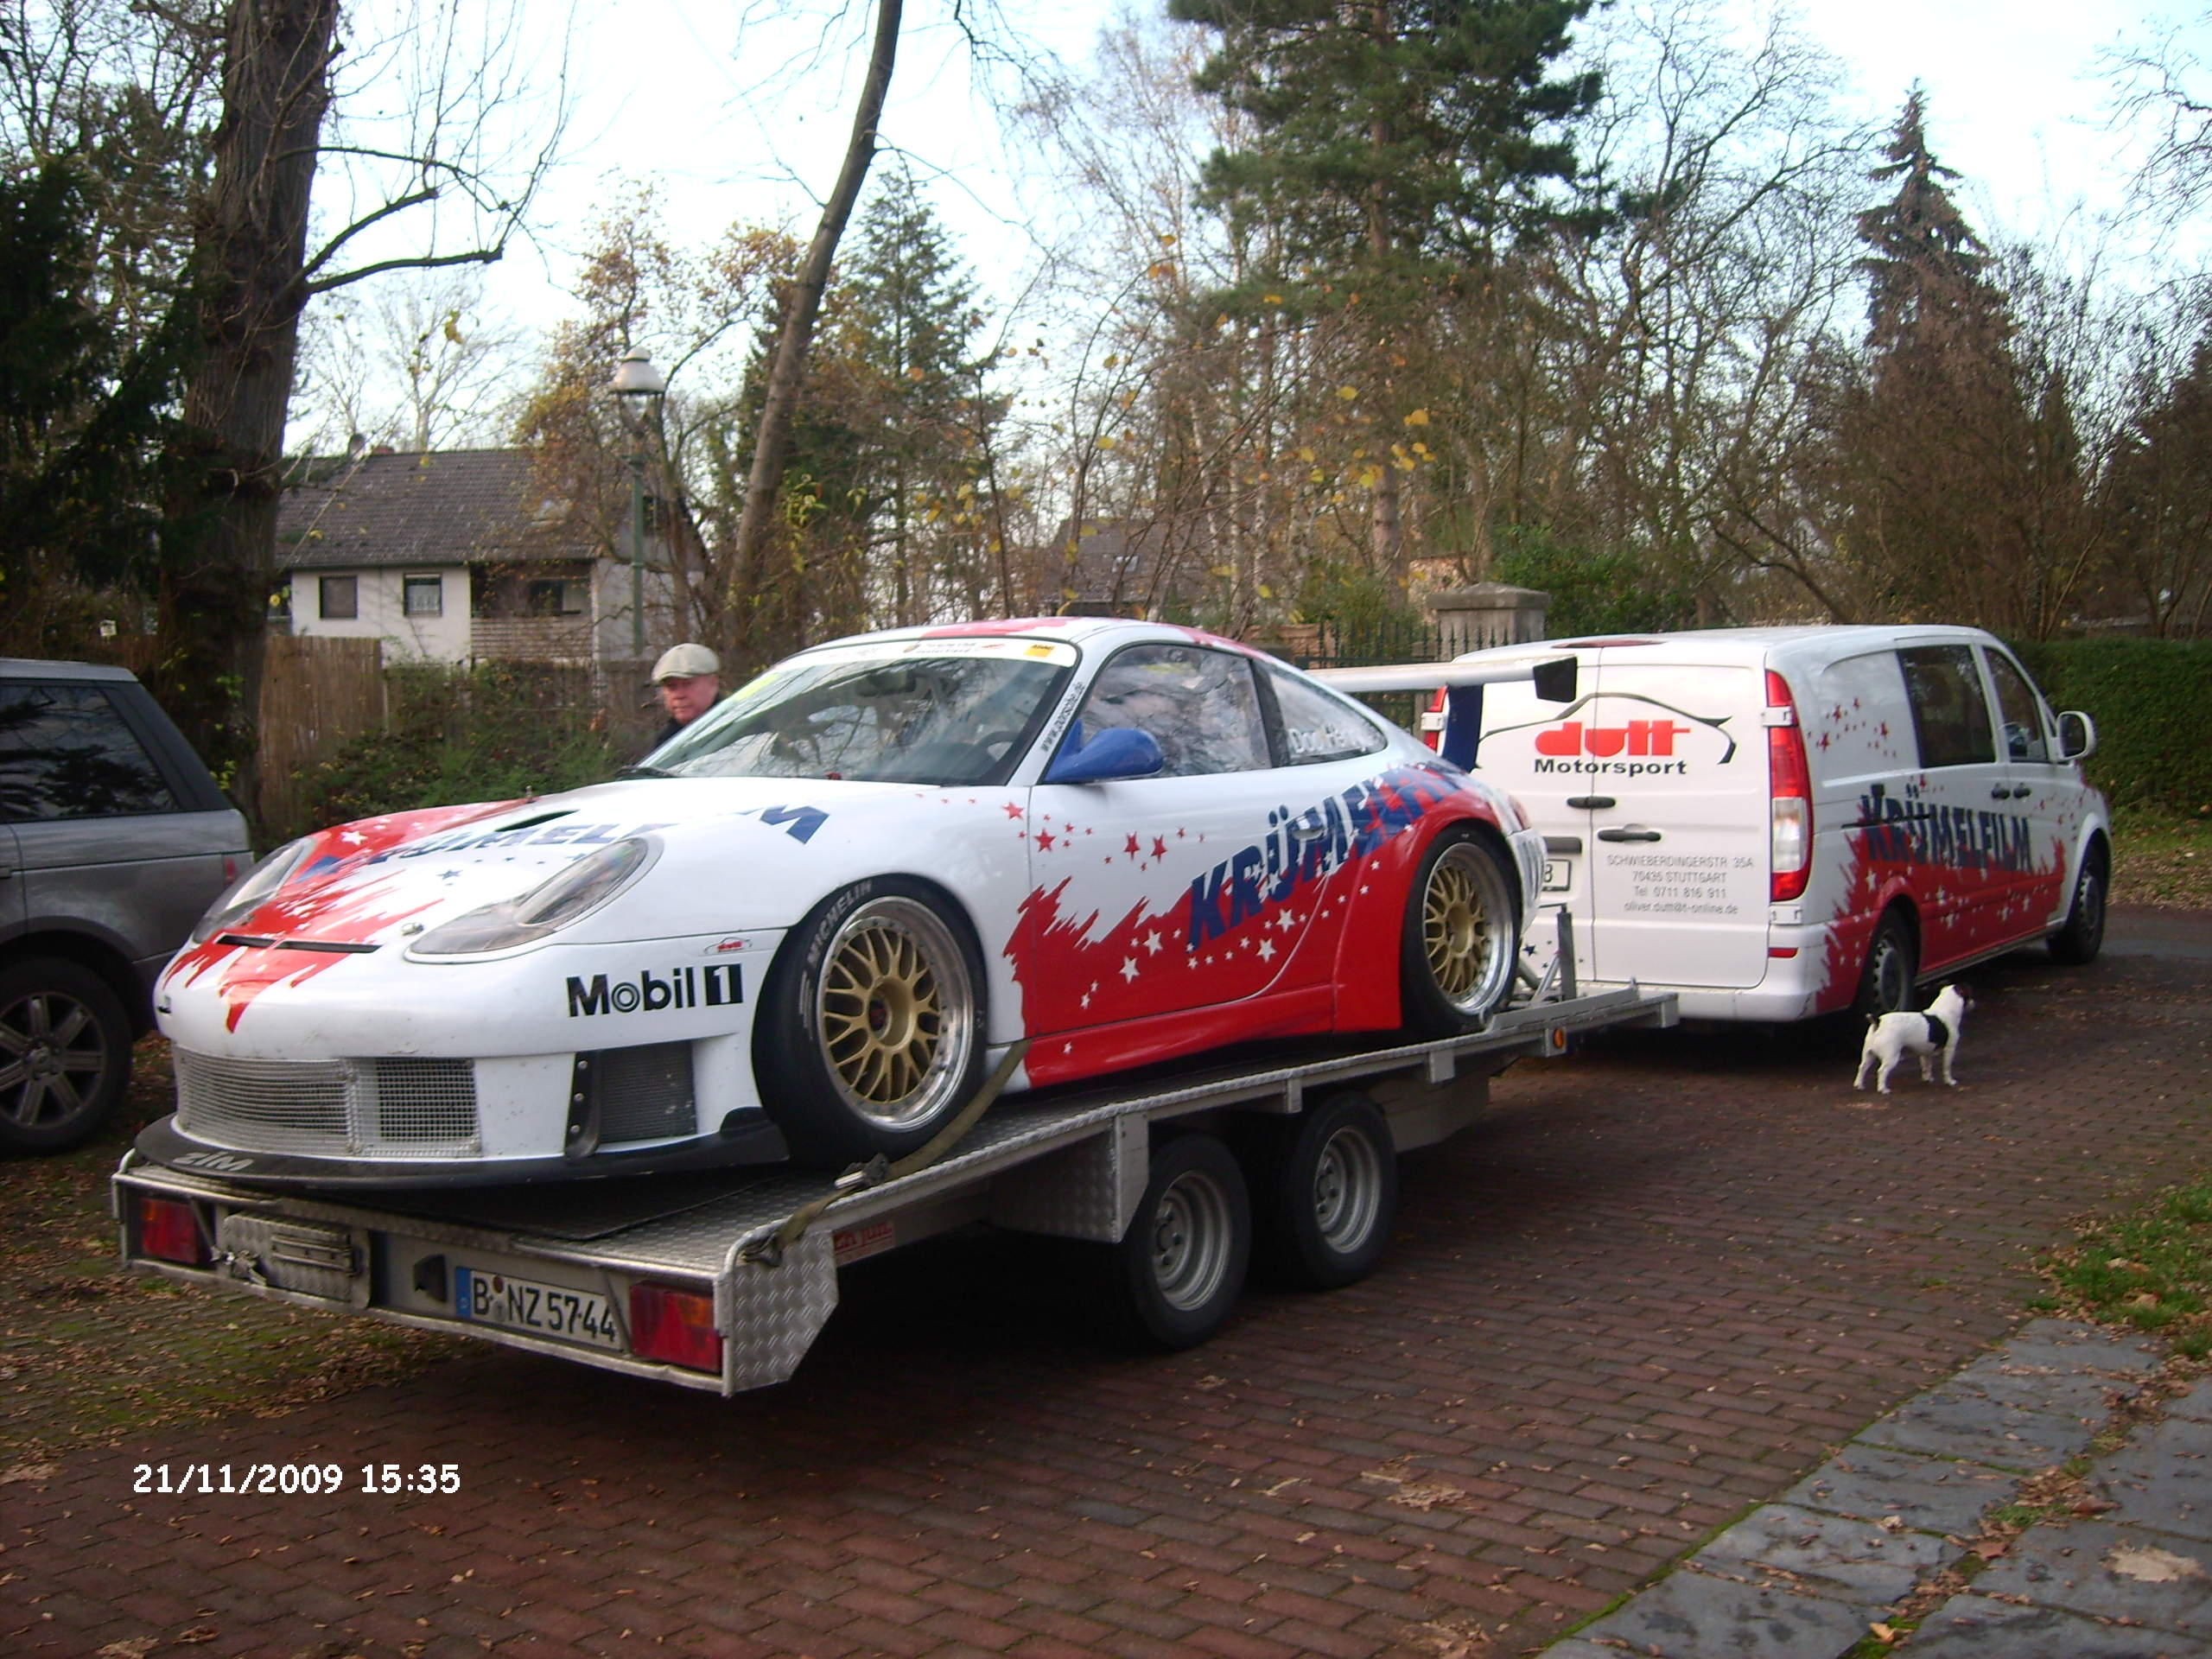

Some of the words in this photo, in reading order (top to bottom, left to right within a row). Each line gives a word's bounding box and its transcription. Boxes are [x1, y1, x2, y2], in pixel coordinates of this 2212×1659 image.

[1535, 760, 1687, 777] Motorsport
[1665, 872, 1727, 883] STUTTGART
[807, 880, 873, 968] MICHELIN
[566, 966, 696, 1018] Mobil
